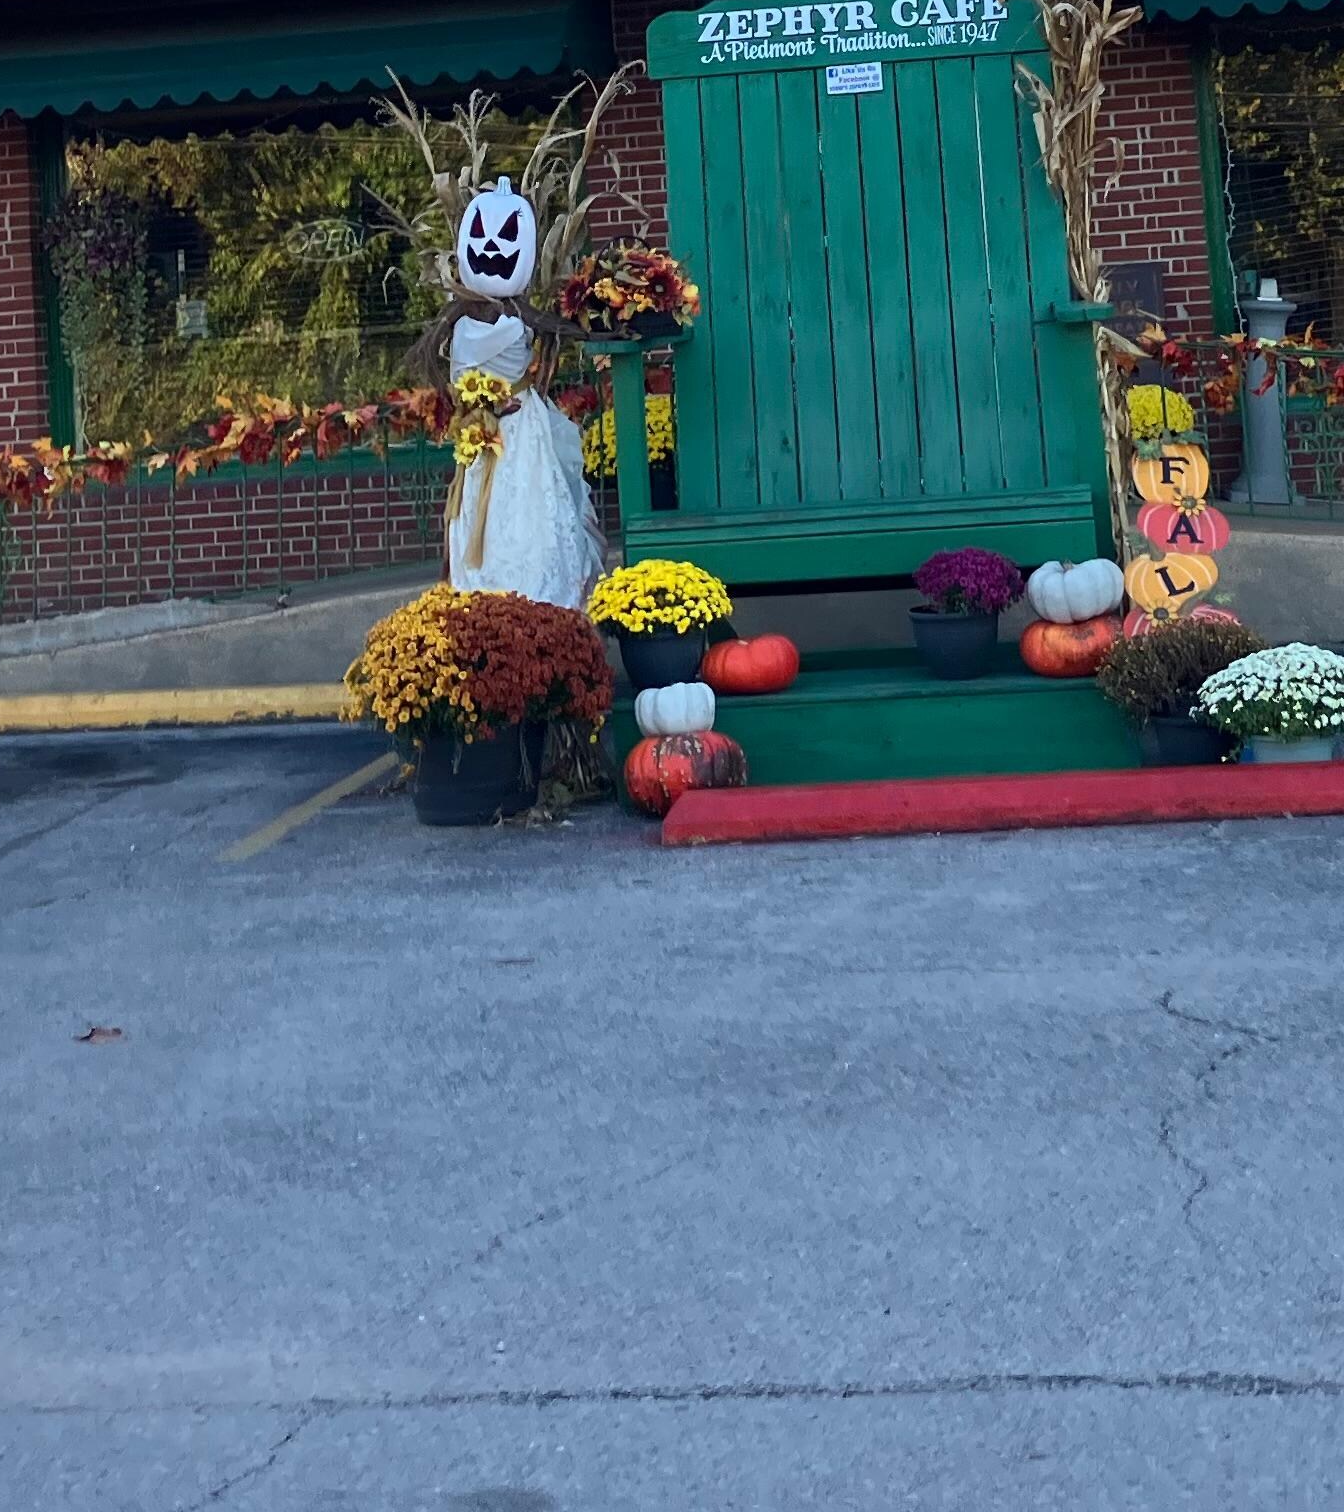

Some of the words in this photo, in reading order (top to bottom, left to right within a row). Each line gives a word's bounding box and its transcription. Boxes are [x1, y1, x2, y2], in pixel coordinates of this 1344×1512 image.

[697, 0, 878, 43] ZEPHYR
[700, 42, 725, 64] A
[724, 38, 816, 61] Piedmont
[927, 23, 957, 47] SINCE
[959, 20, 1000, 46] 1947
[286, 225, 366, 254] OPEN
[1154, 456, 1205, 598] FAL
